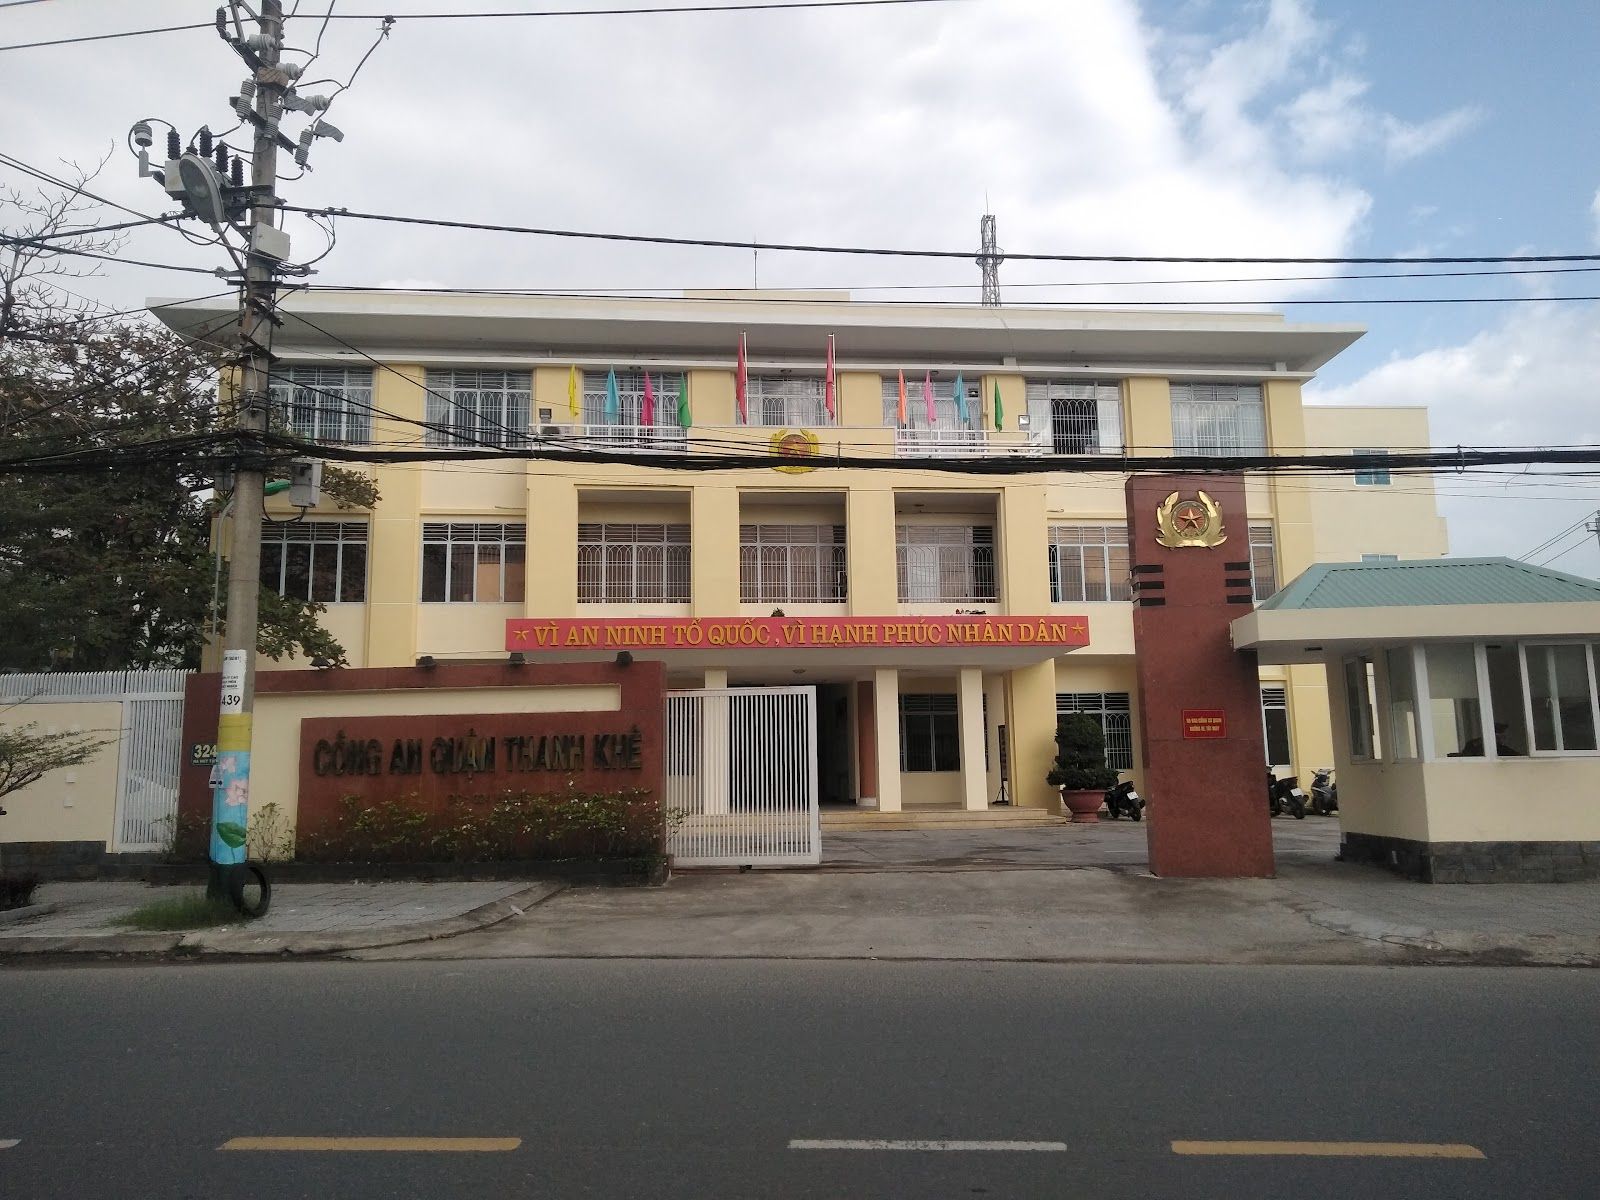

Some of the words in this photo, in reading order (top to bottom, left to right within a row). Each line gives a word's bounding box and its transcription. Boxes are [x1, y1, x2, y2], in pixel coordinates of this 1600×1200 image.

[534, 621, 559, 646] VÌ
[565, 625, 599, 645] AN
[605, 625, 667, 645] NINH
[672, 618, 703, 645] TỔ
[781, 620, 807, 644] VÌ
[810, 623, 878, 646] HẠNH
[883, 618, 941, 644] PHÚC
[946, 619, 1015, 643] NHÂN
[1018, 619, 1067, 643] DÂN
[194, 744, 217, 758] 324
[313, 729, 383, 777] CÔNG
[390, 738, 423, 776] AN
[430, 728, 496, 783] QUẬN
[503, 734, 586, 773] THANH
[593, 723, 642, 771] KHÊ
